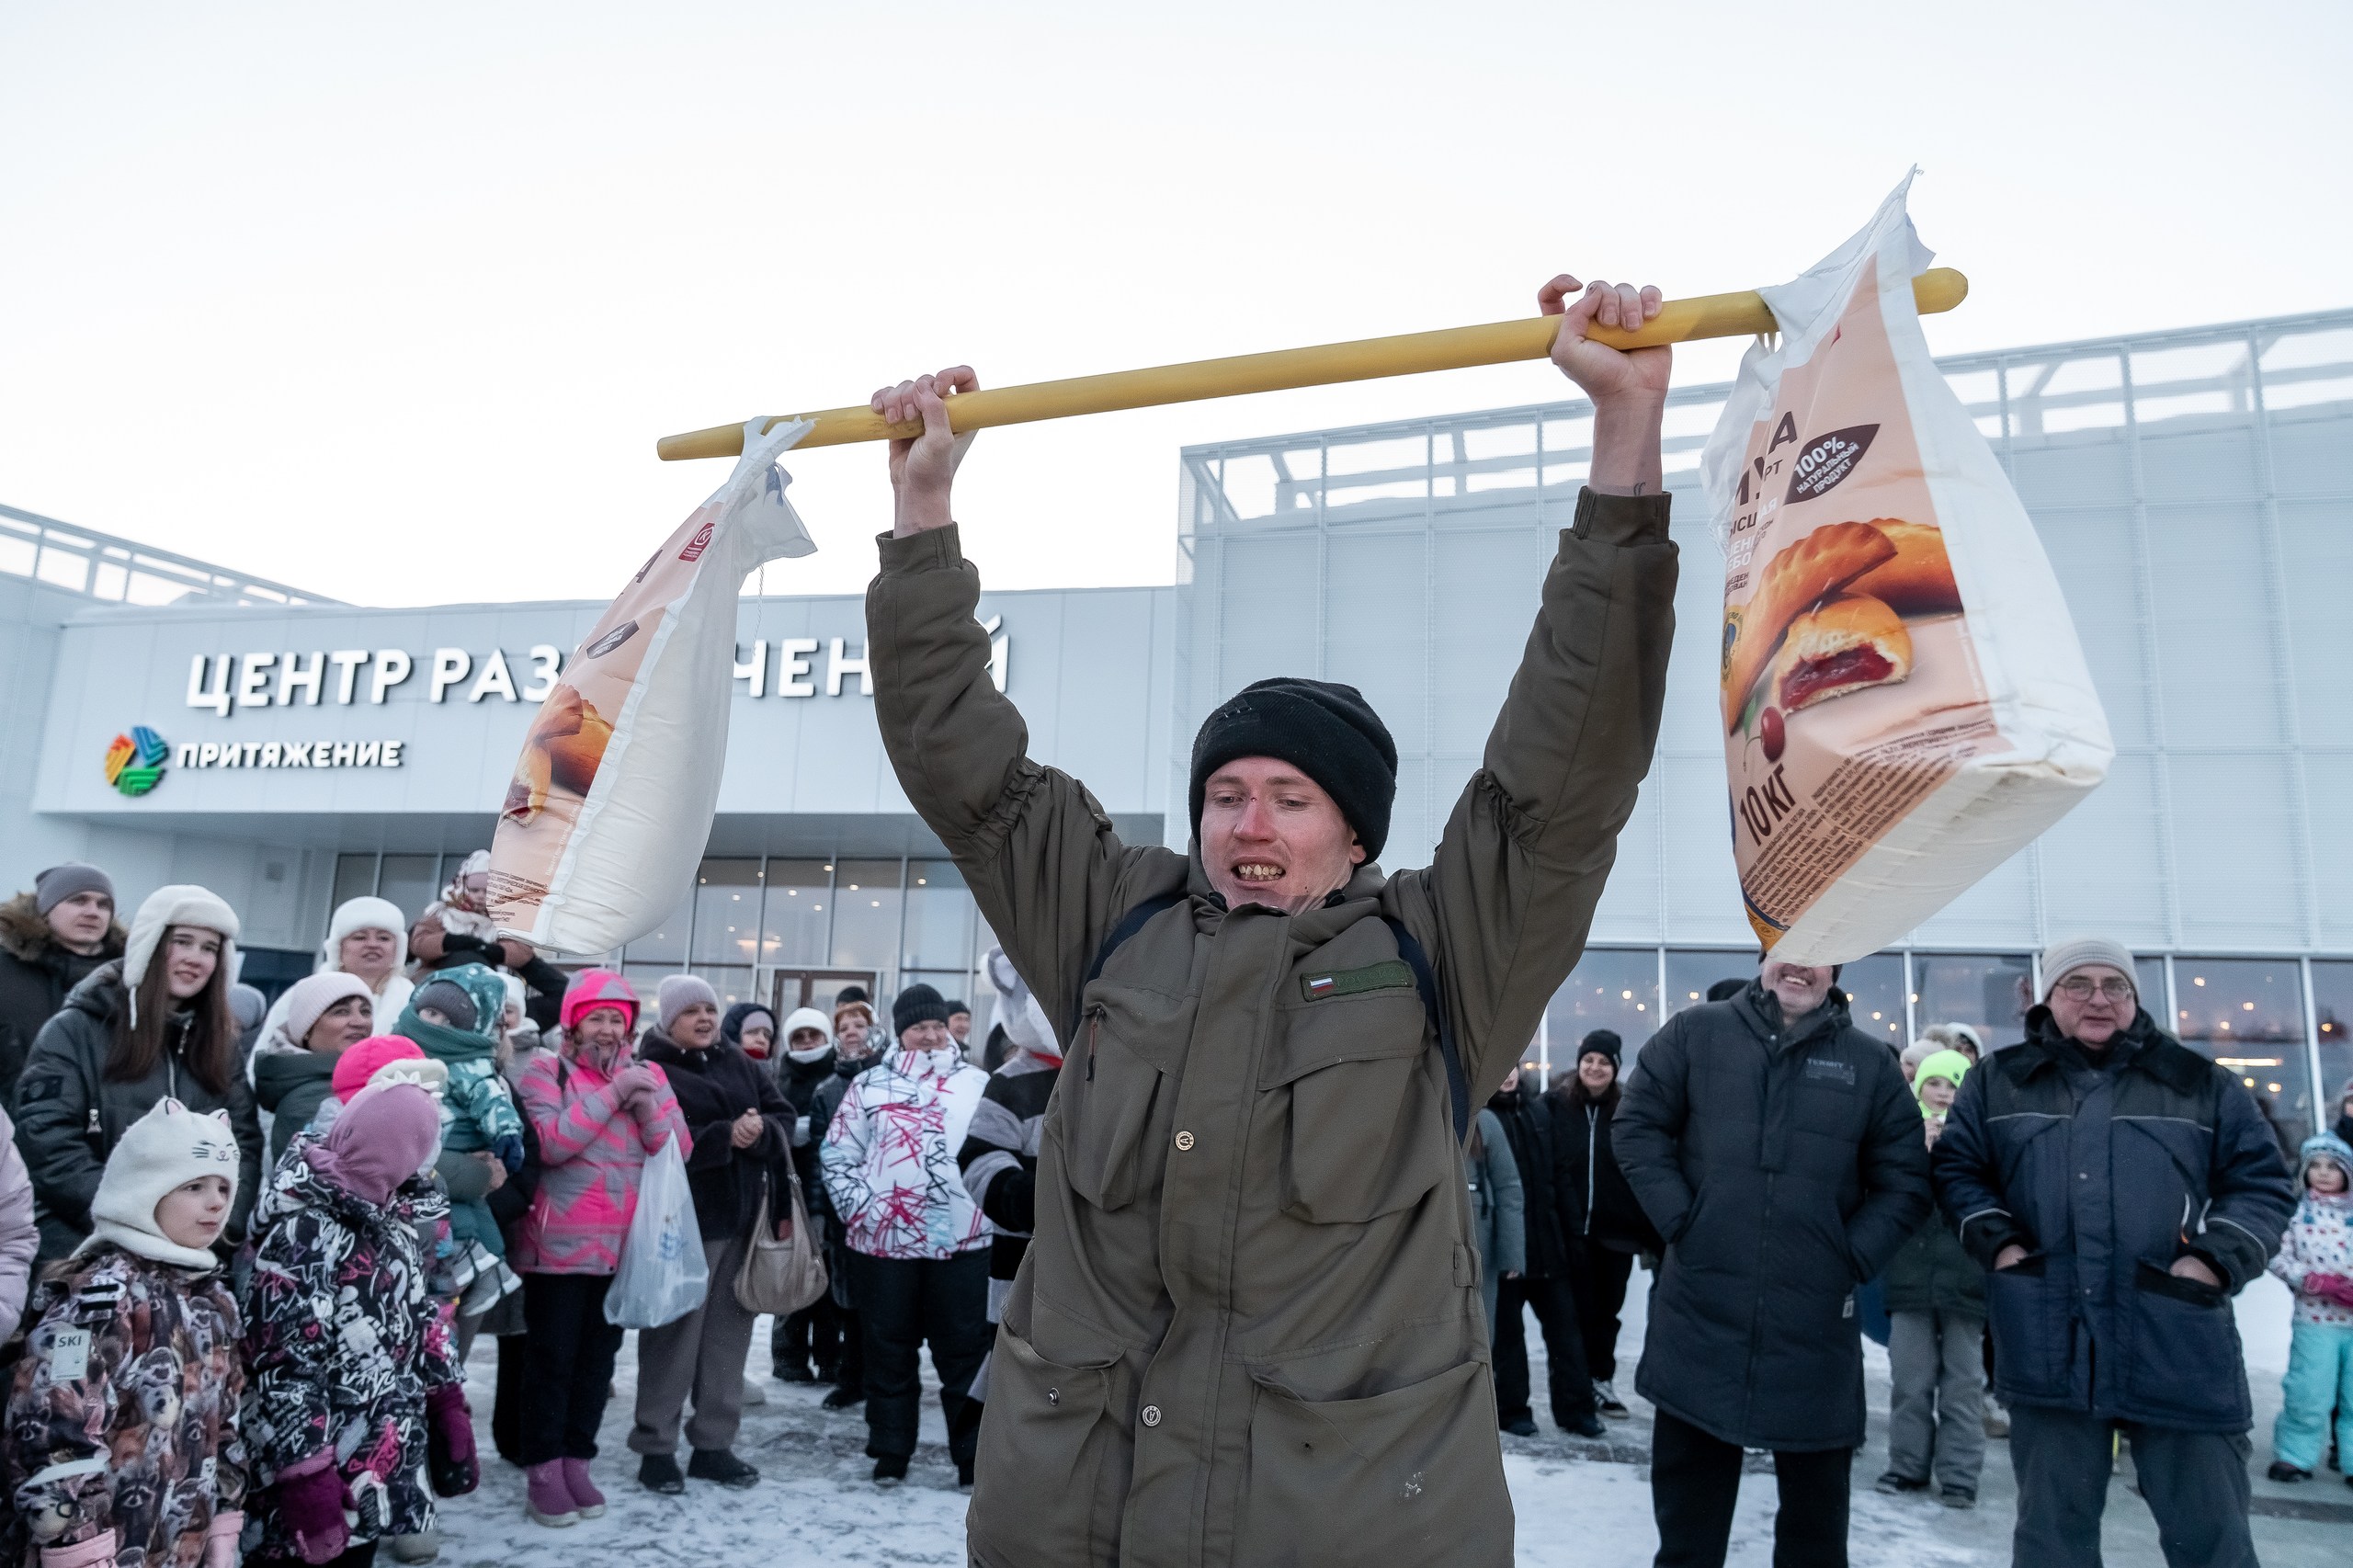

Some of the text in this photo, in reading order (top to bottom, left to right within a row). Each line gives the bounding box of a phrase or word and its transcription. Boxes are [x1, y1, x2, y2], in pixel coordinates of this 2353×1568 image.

[1794, 436, 1846, 478] 100%
[1796, 442, 1859, 494] НАТУРАЛЬНЫЙ
[1813, 459, 1852, 494] ПРОДУКТ
[187, 614, 1009, 717] ЦЕНТР РАЗЧЕН
[176, 740, 404, 768] ПРИТЯЖЕНИЕ
[1739, 785, 1771, 846] 10
[1761, 763, 1796, 823] КГ
[57, 1335, 82, 1347] SKI
